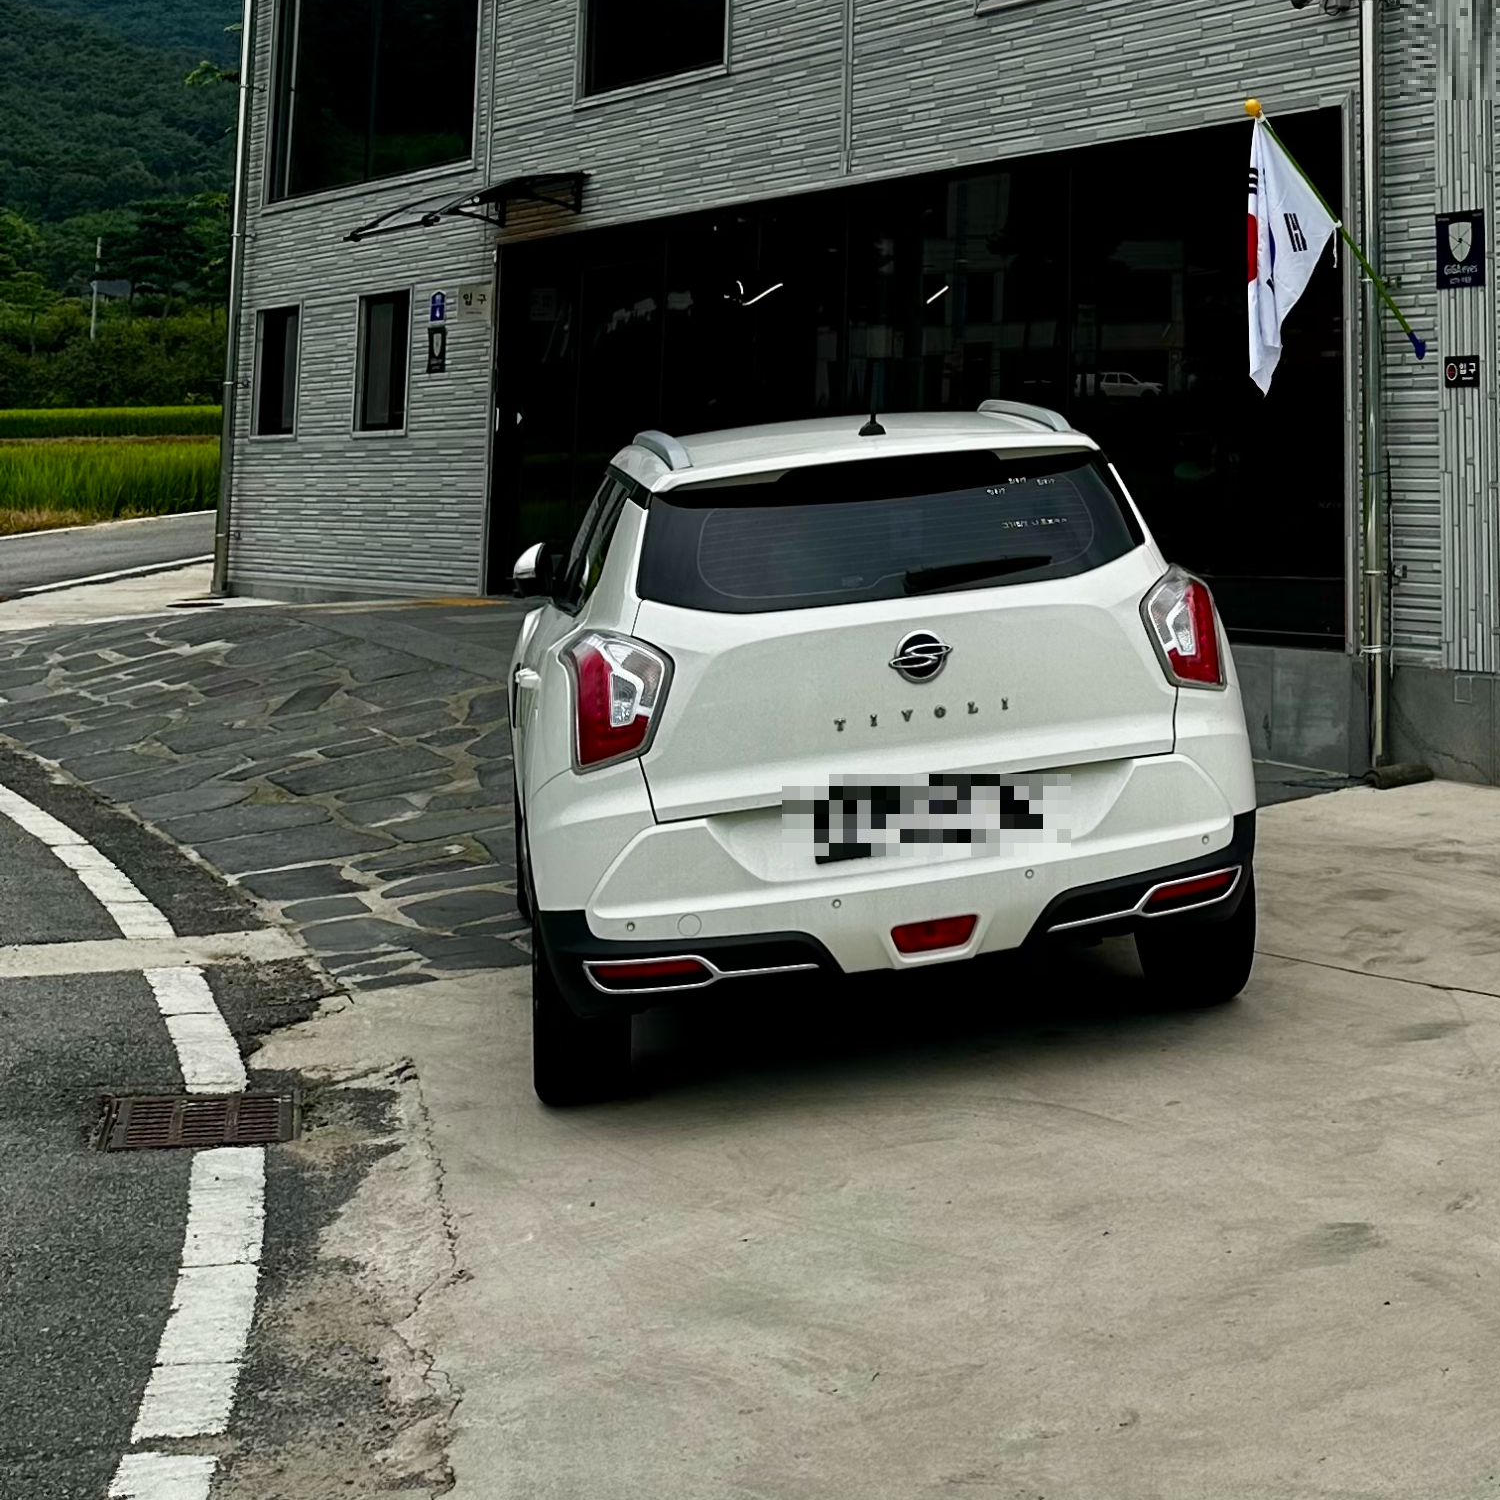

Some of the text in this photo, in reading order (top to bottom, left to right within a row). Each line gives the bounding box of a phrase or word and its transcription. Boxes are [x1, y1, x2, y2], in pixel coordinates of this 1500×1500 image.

[462, 292, 487, 306] 입구
[1459, 362, 1477, 374] 입구
[834, 697, 1009, 732] TIVOLI
